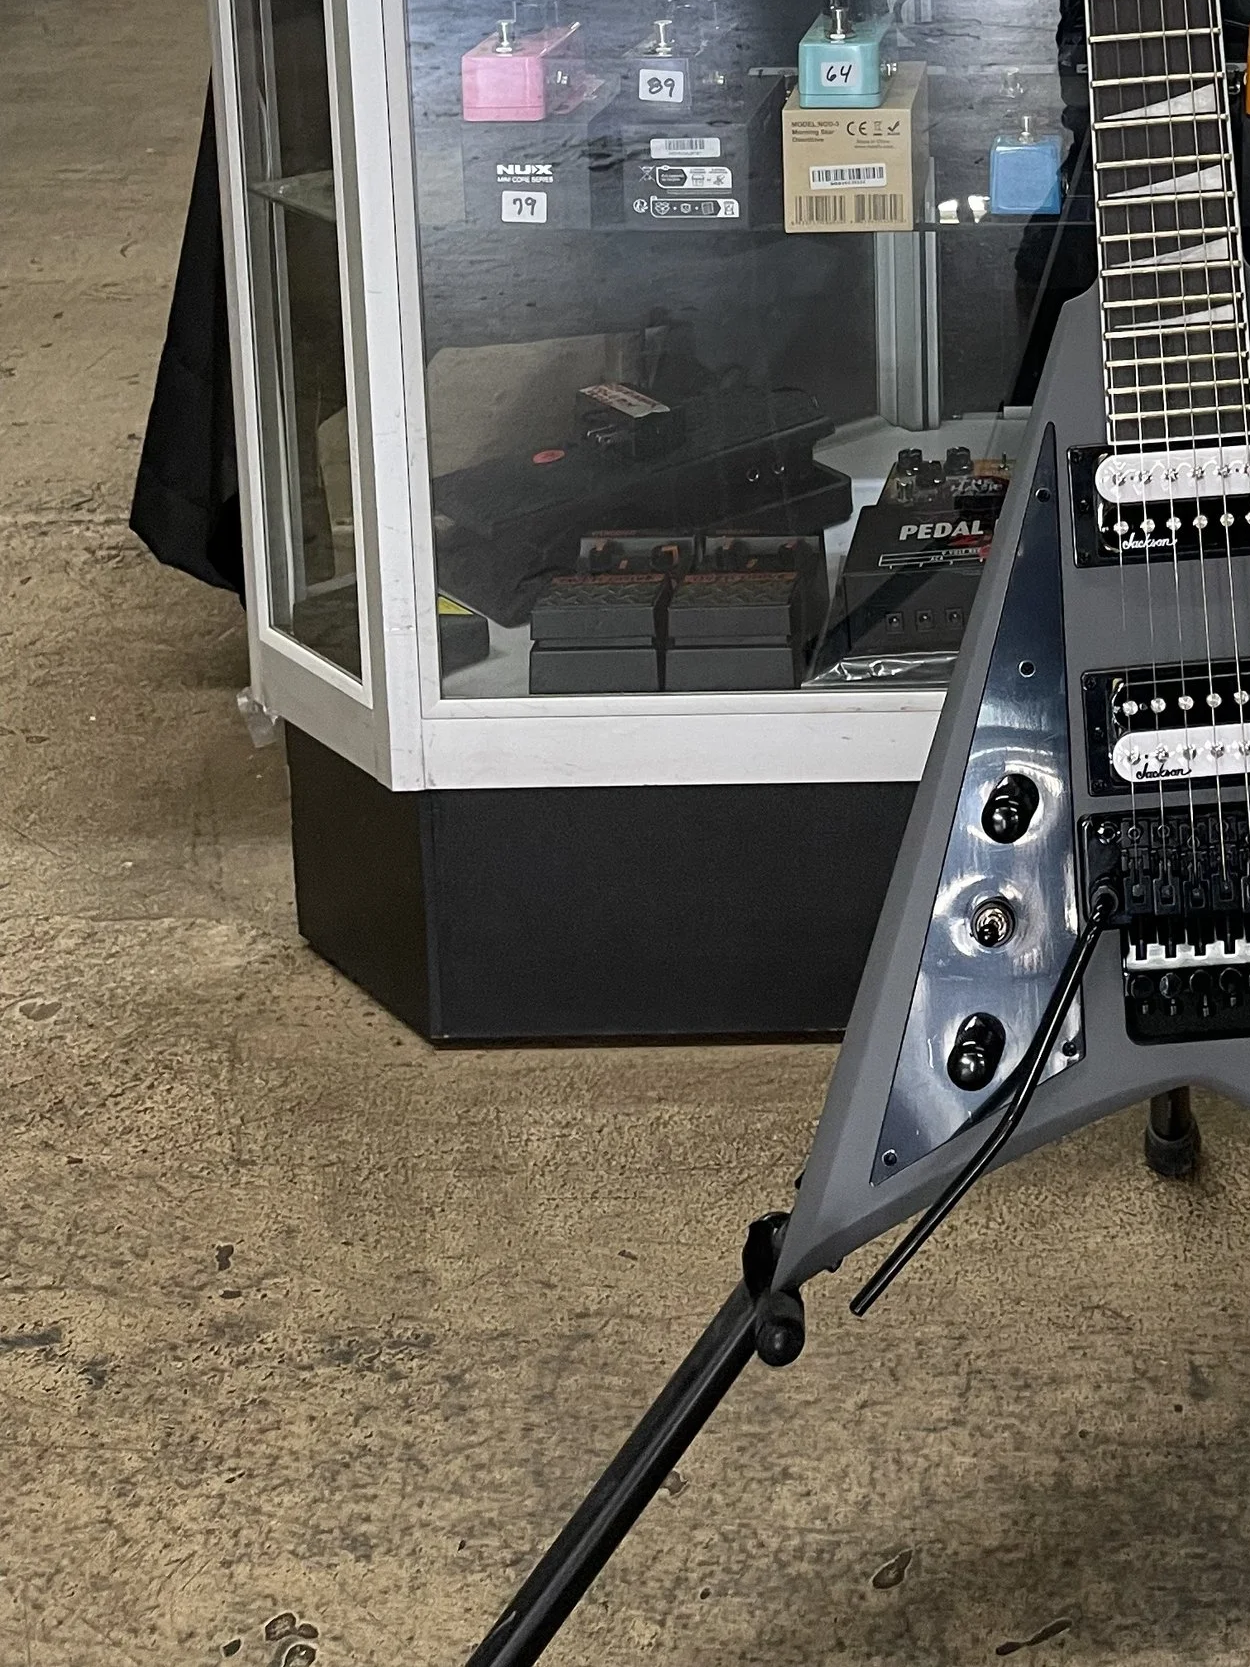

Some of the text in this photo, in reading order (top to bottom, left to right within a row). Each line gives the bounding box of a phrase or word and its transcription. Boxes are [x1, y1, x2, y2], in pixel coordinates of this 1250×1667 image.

[826, 64, 852, 83] 64
[646, 76, 676, 98] 89
[496, 164, 553, 175] NUX
[512, 197, 537, 216] 79
[898, 520, 985, 542] PEDAL
[1121, 531, 1178, 550] Jackson
[1135, 762, 1192, 780] Jackson
